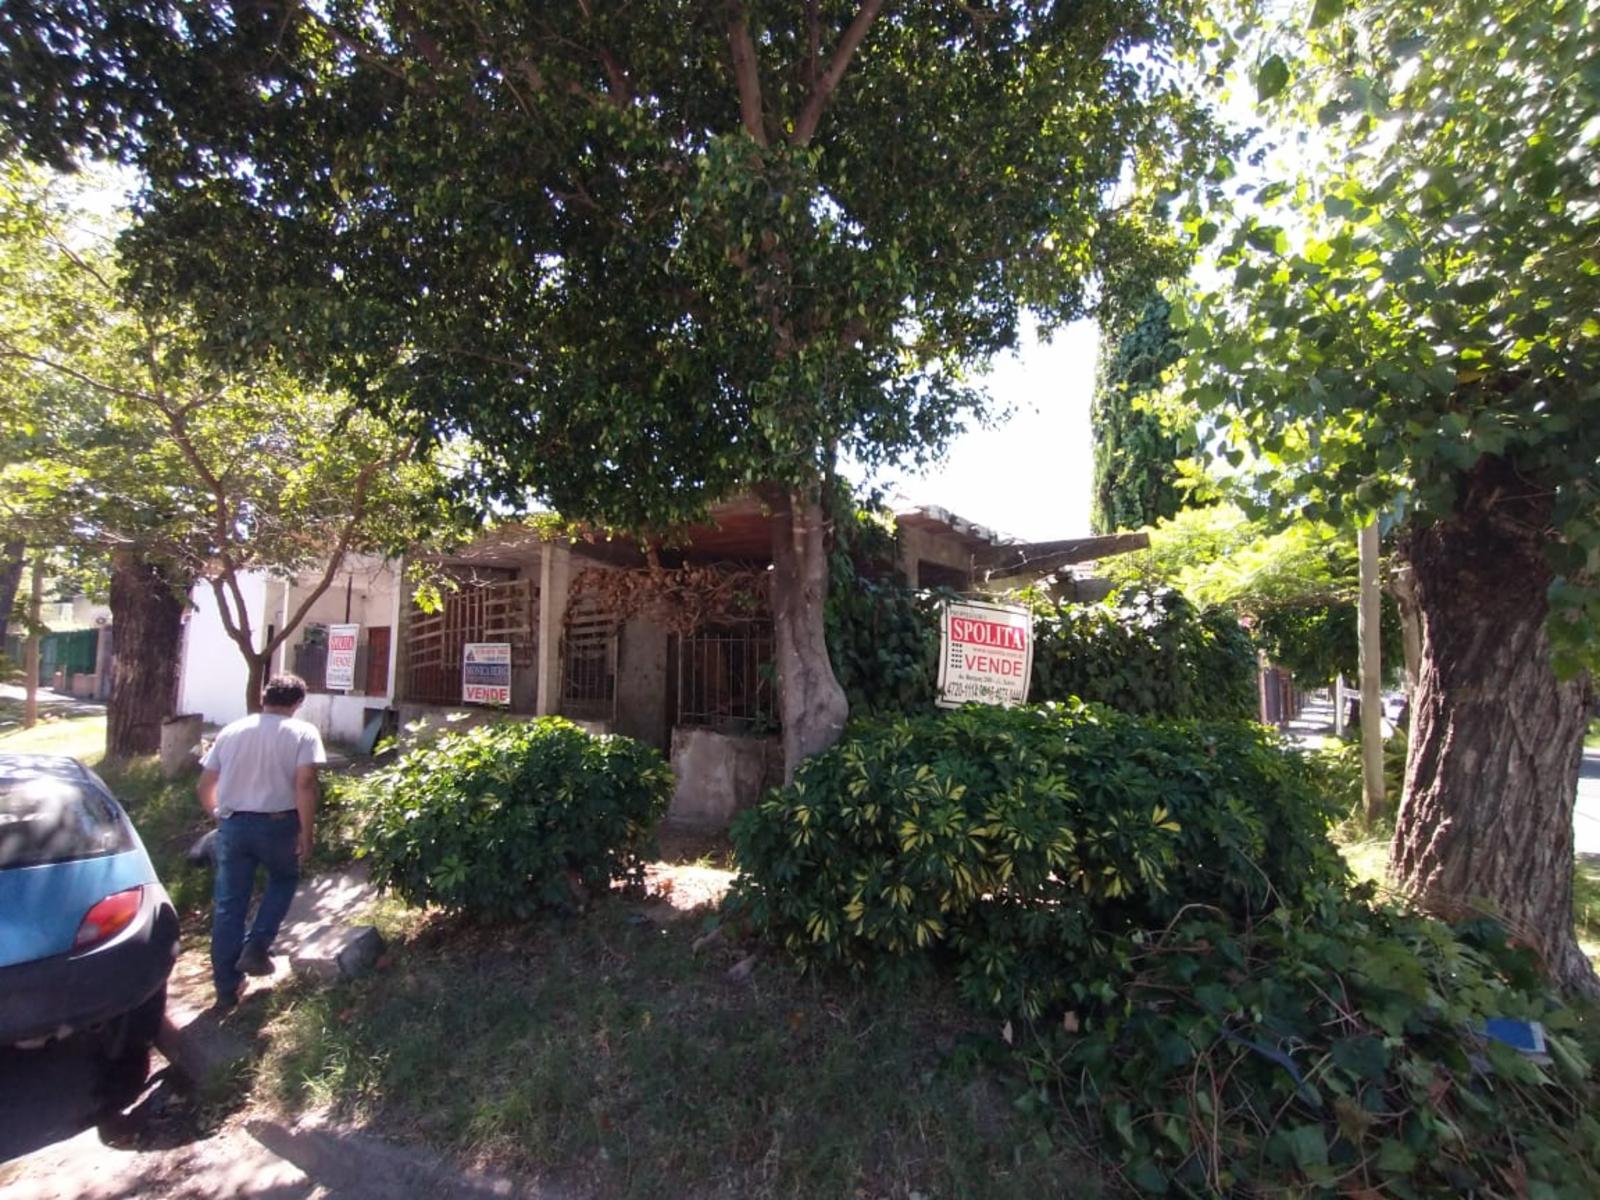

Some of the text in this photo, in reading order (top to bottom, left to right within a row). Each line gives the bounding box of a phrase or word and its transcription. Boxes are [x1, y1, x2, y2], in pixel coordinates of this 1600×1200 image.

[953, 618, 1023, 650] SPOLITA
[965, 654, 1023, 677] VENDE
[466, 687, 508, 702] VENDE
